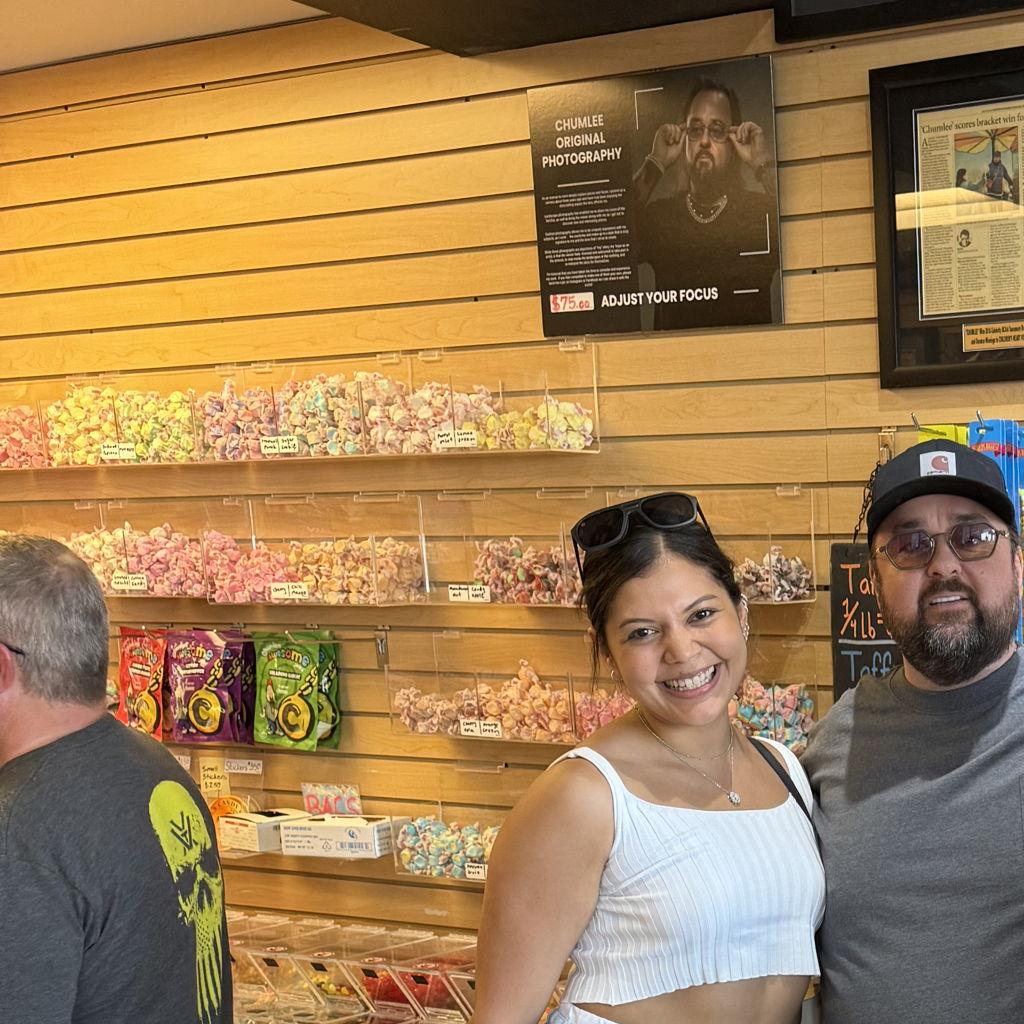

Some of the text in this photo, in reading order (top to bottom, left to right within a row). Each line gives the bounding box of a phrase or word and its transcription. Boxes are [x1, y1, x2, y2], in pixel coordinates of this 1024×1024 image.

[555, 114, 604, 131] CHUMLEE
[954, 118, 975, 129] scores
[976, 116, 1001, 126] bracket
[1003, 113, 1016, 122] win
[555, 131, 606, 149] ORIGINAL
[542, 147, 622, 168] PHOTOGRAPHY
[601, 287, 719, 307] ADJUST YOUR FOCUS
